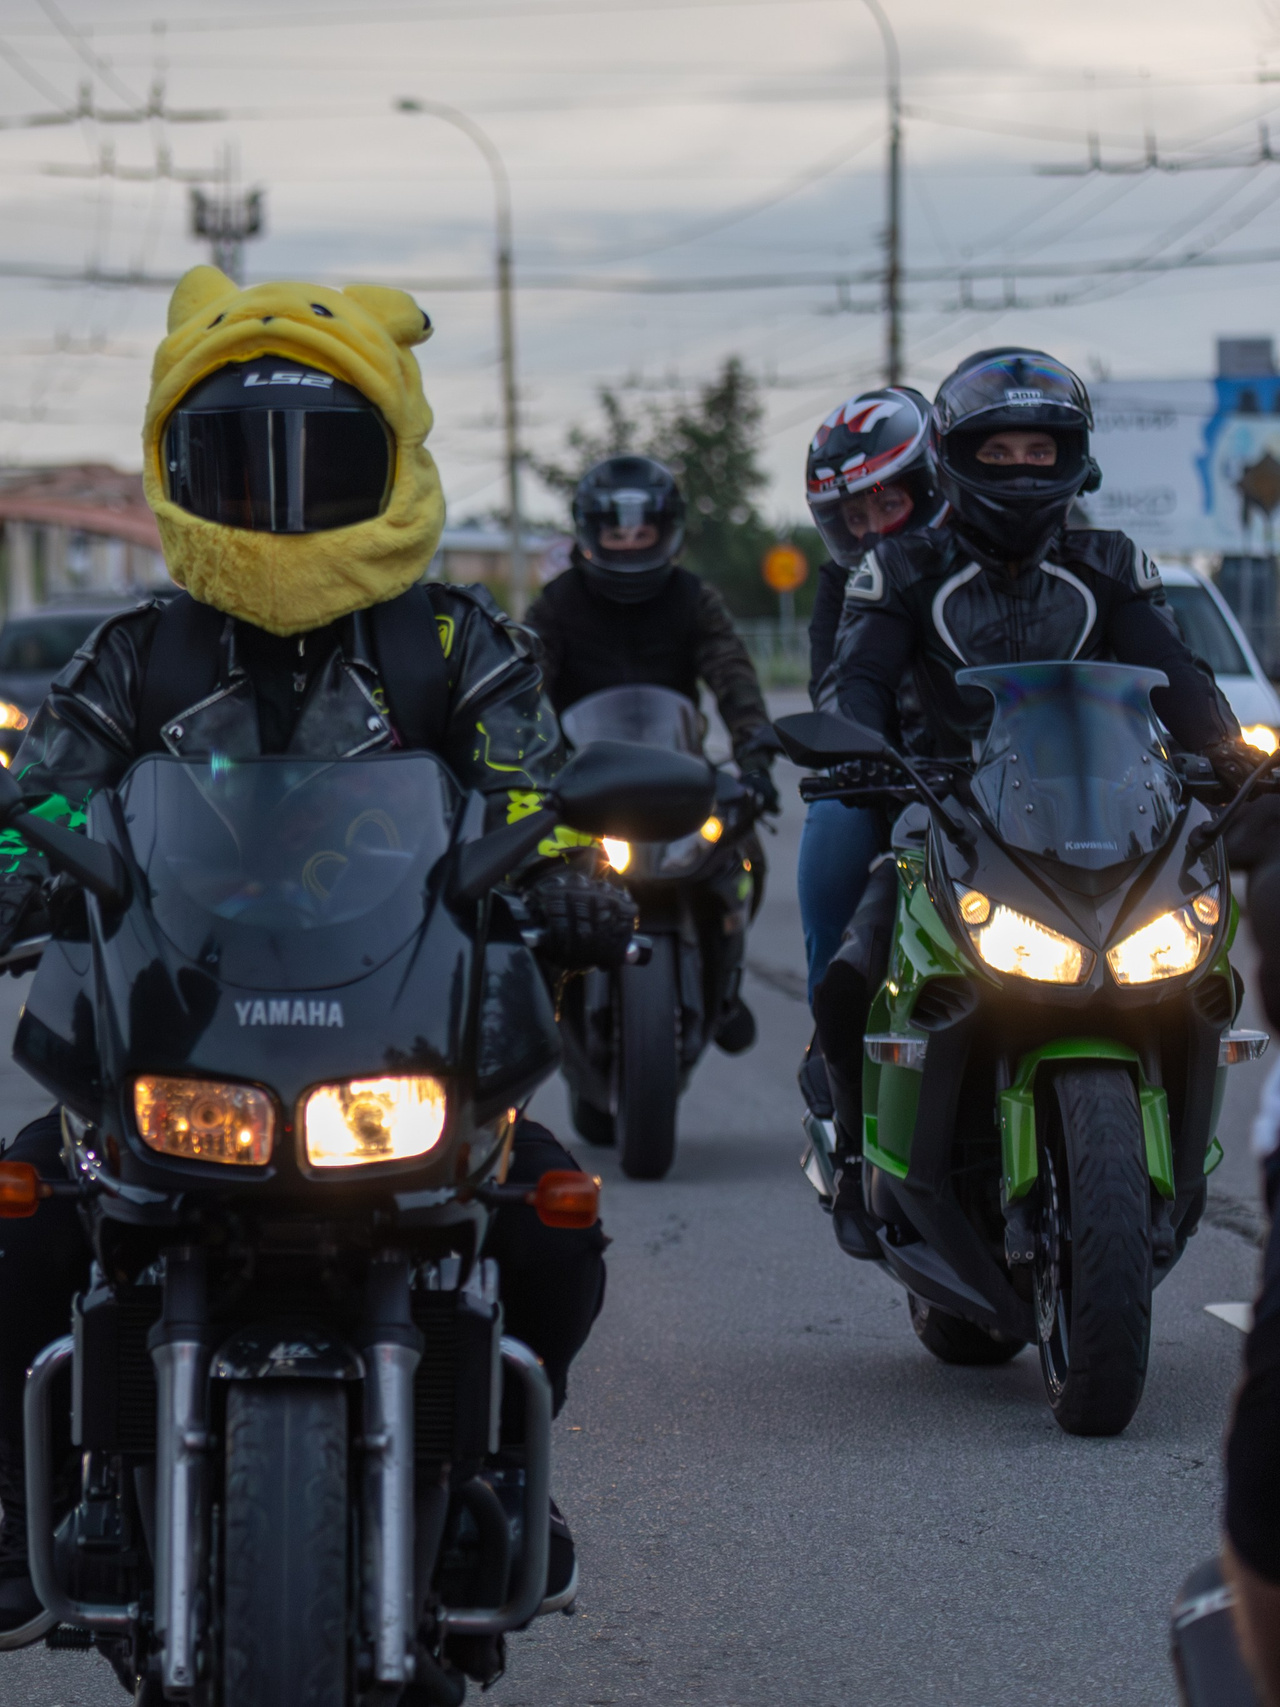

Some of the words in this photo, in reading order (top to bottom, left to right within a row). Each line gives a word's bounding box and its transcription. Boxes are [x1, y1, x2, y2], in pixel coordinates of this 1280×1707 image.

[243, 371, 334, 389] LS2
[1064, 841, 1118, 851] Kawasaki
[234, 999, 344, 1028] YAMAHA
